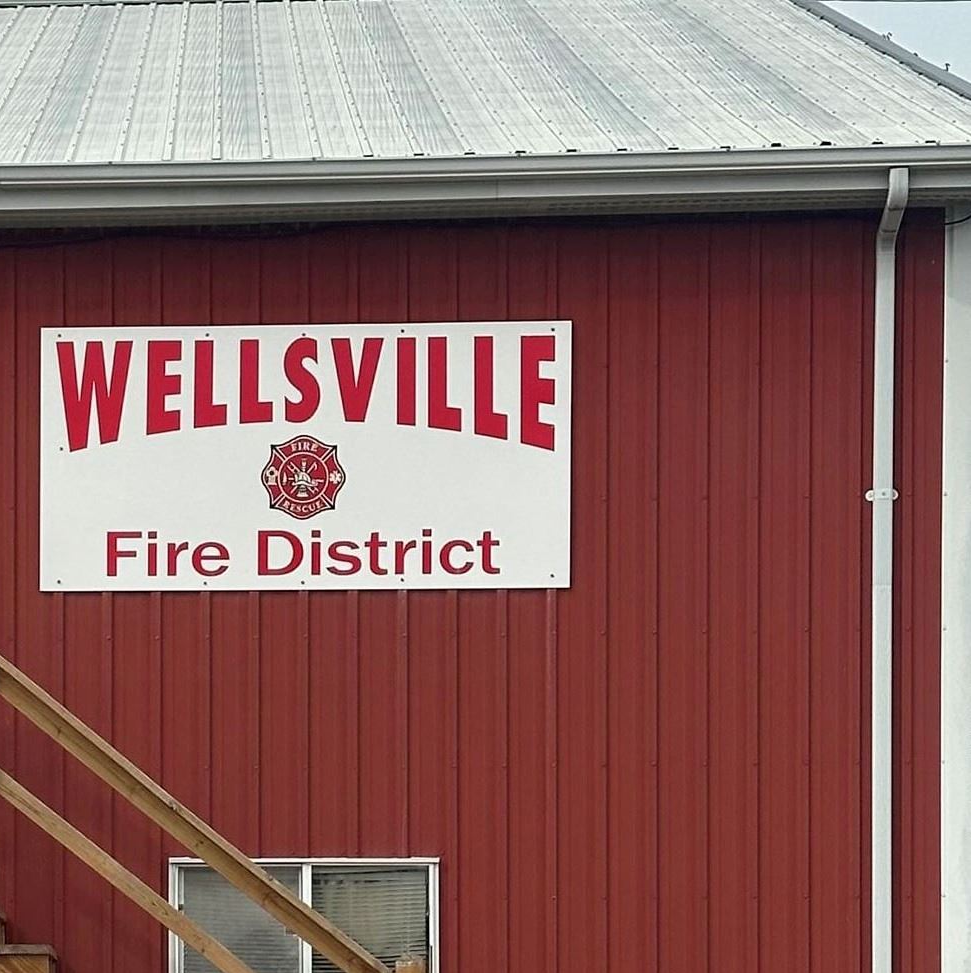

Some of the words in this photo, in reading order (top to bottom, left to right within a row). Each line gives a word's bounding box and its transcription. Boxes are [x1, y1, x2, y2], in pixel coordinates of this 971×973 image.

[56, 335, 556, 452] WELLSVILLE
[291, 442, 318, 452] FIRE
[284, 501, 323, 513] RESCUE
[107, 530, 229, 577] Fire
[257, 529, 501, 576] District
